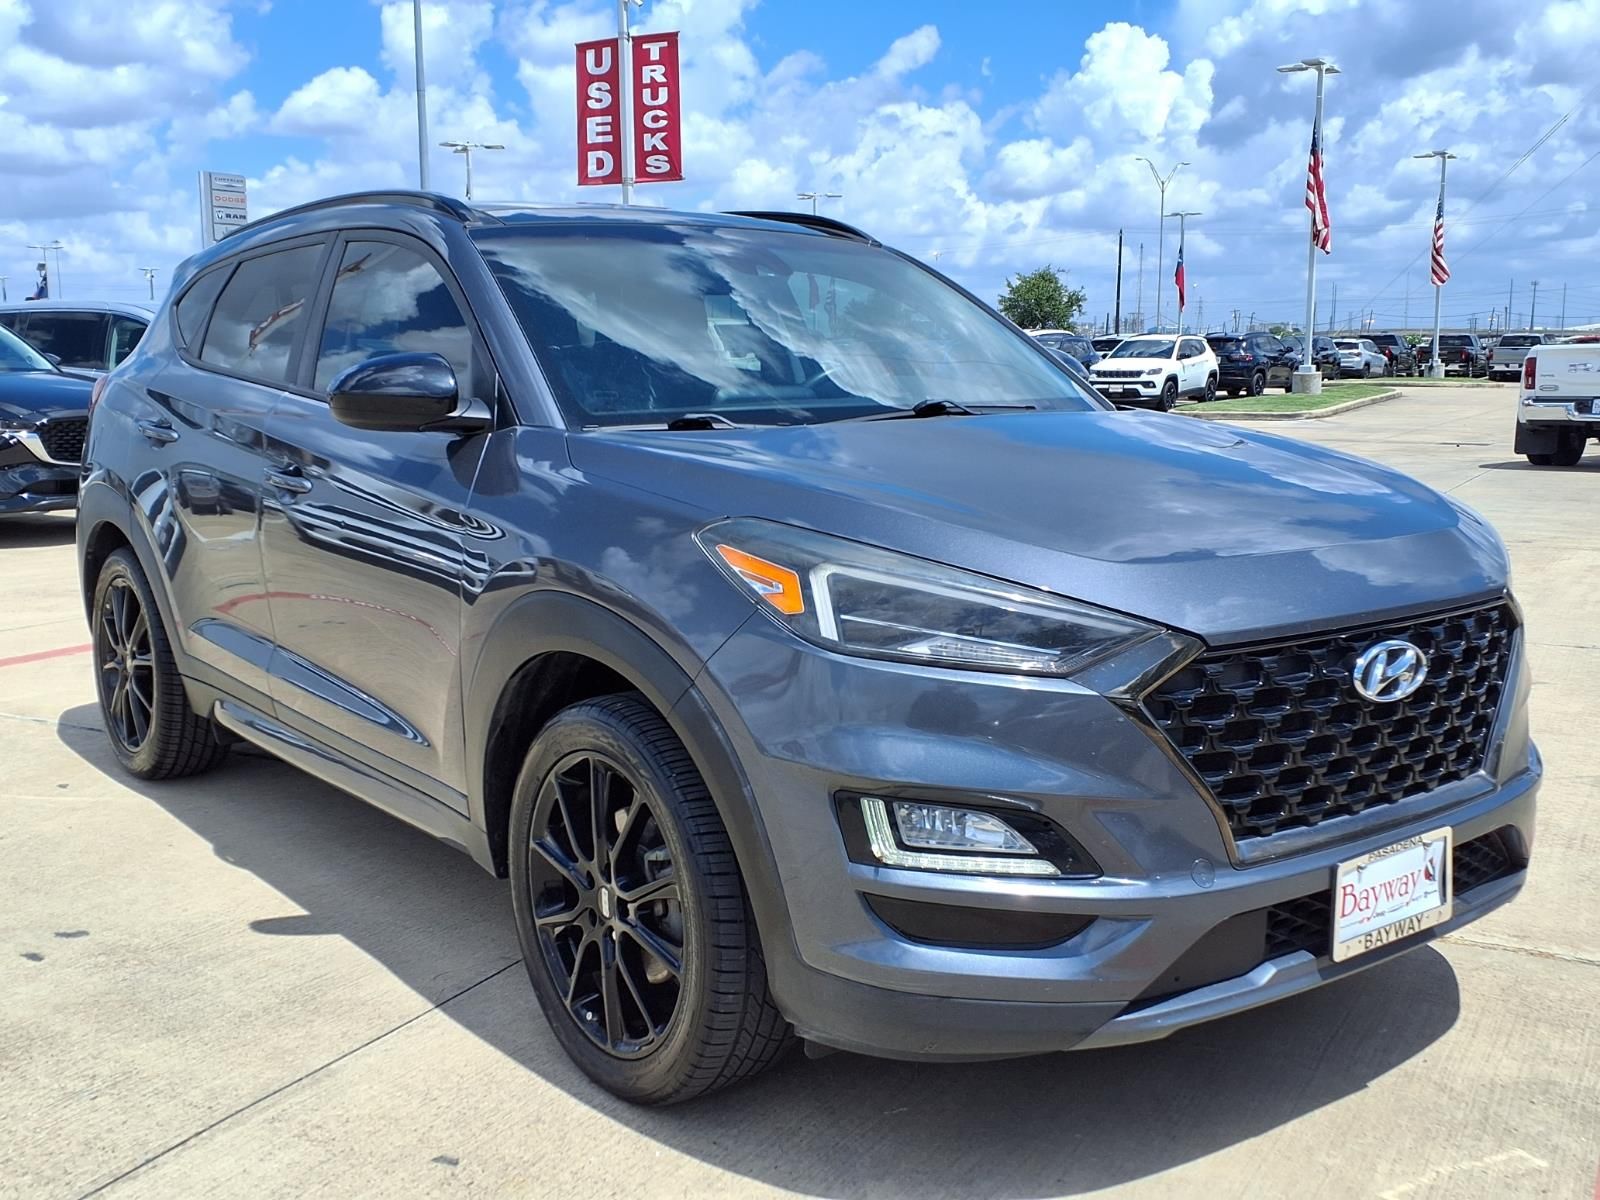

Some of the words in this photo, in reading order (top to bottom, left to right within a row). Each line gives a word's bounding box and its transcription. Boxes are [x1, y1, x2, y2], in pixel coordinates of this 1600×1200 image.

[585, 46, 614, 178] USED
[642, 41, 671, 174] TRUCKS
[1367, 836, 1424, 862] PASADENA
[1339, 869, 1422, 924] Bayway
[1364, 913, 1425, 949] BAYWAY
